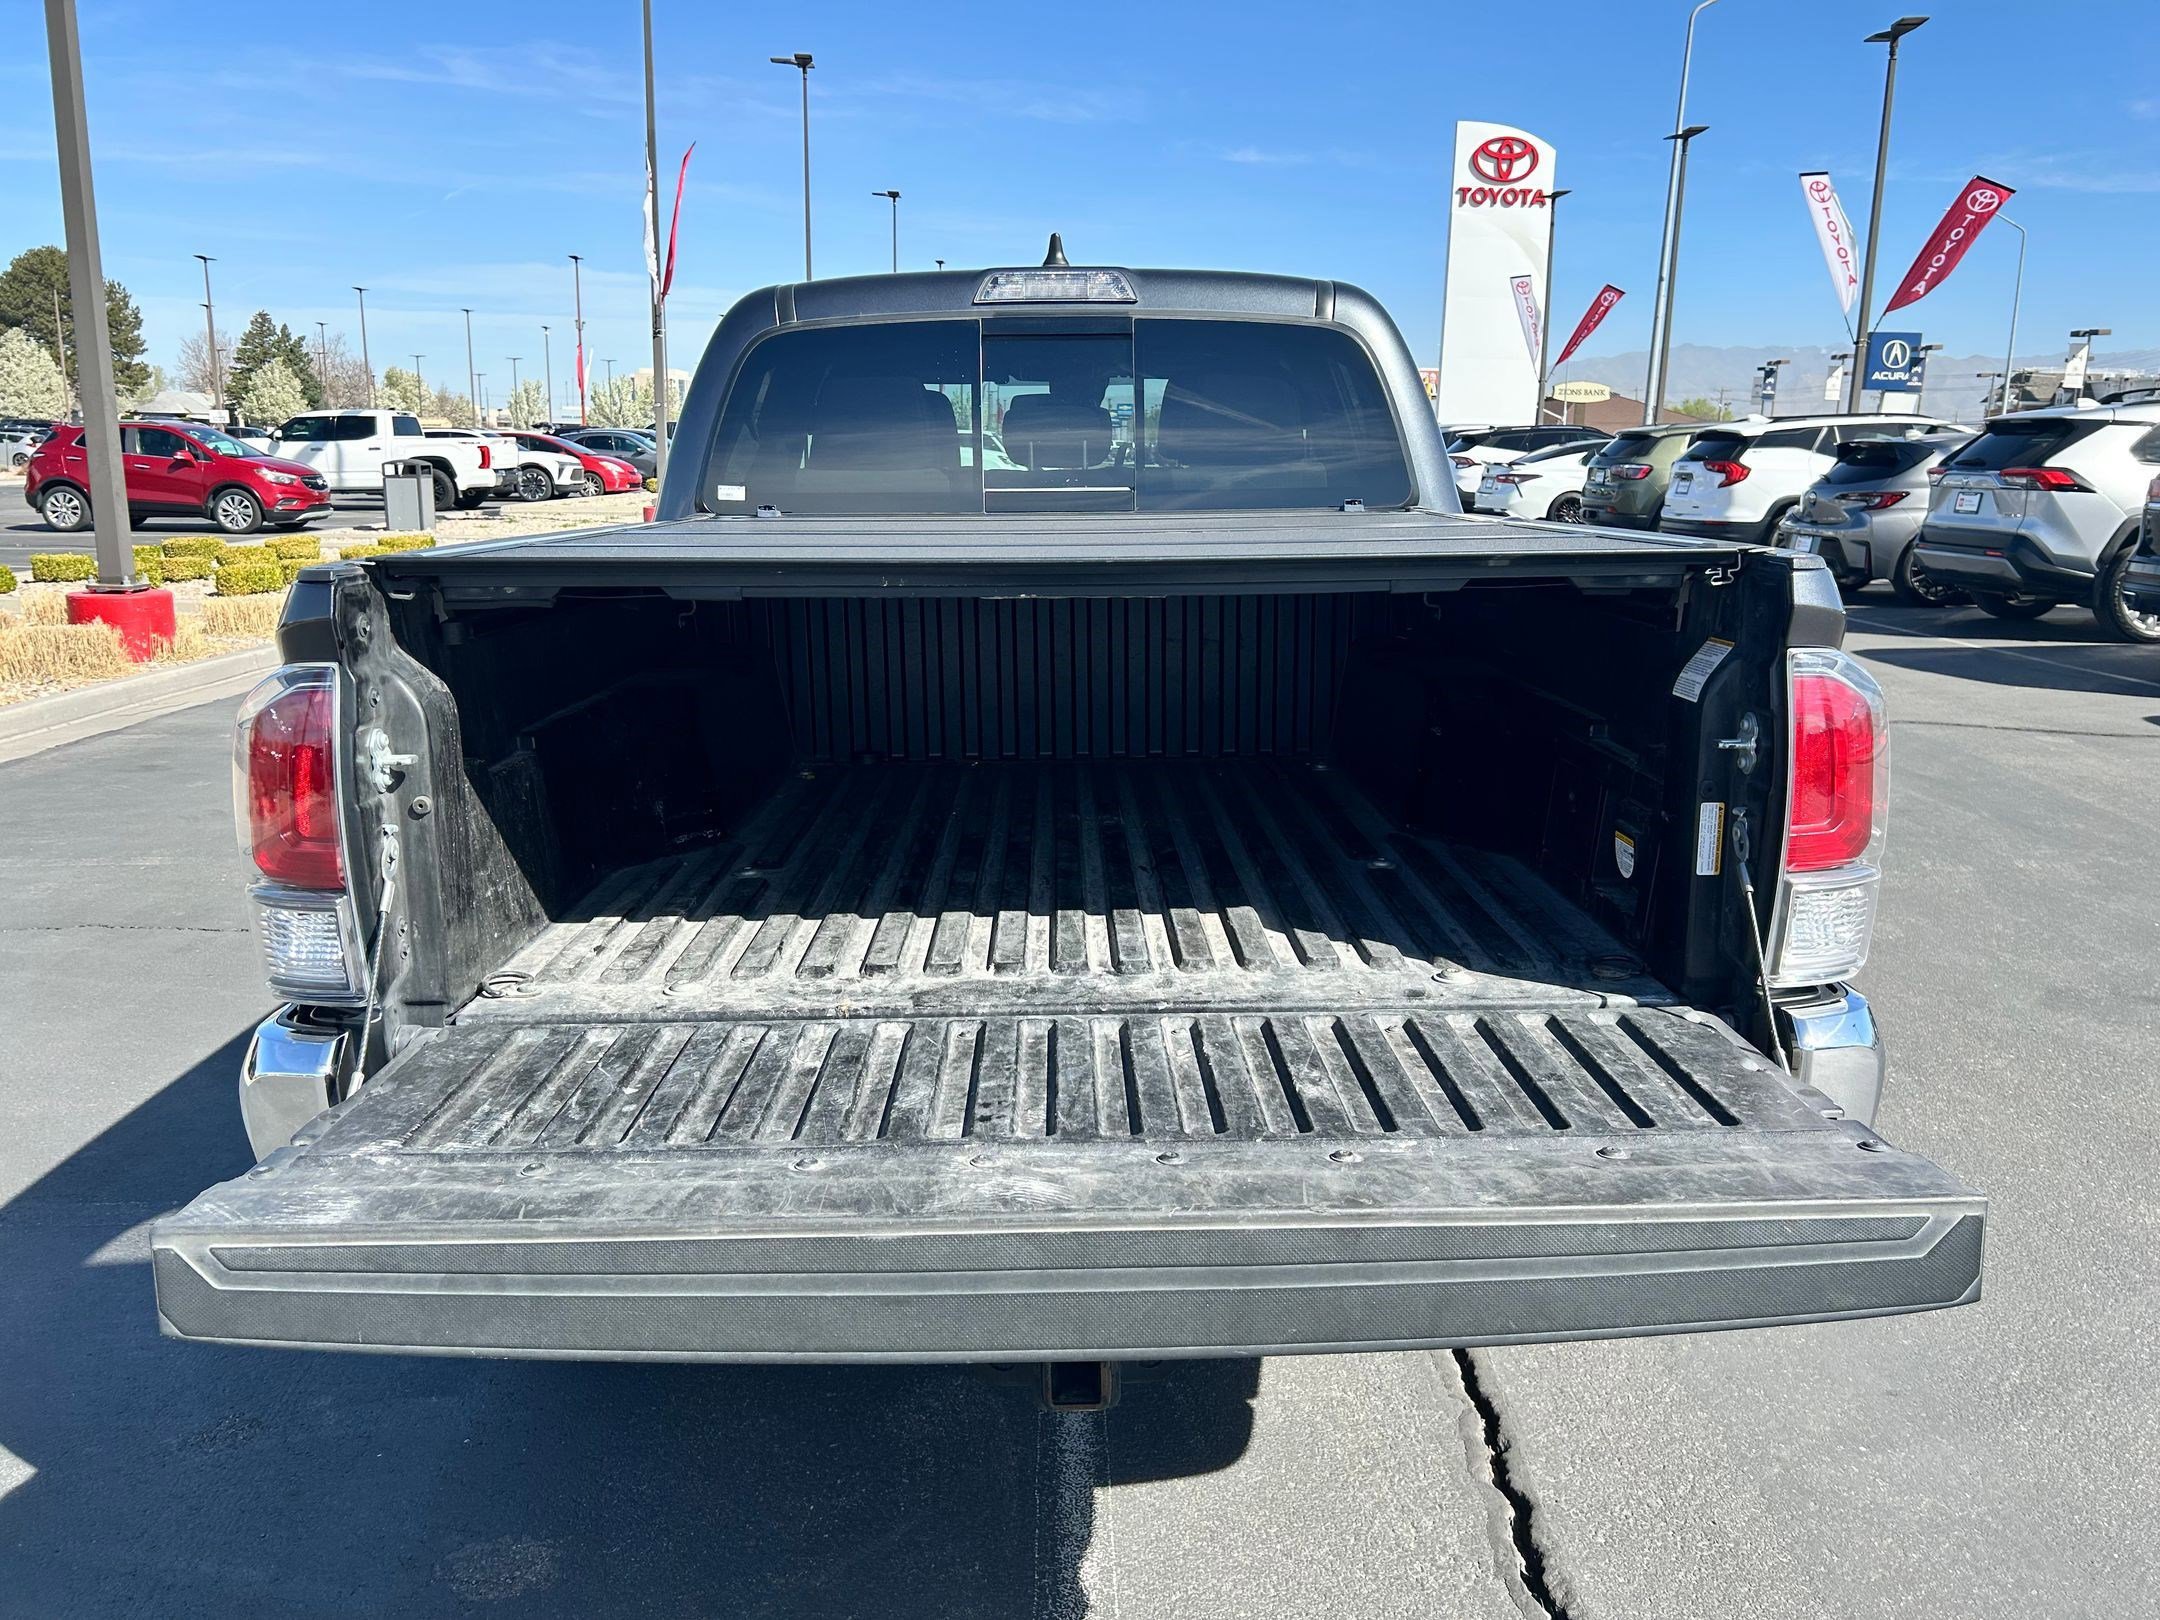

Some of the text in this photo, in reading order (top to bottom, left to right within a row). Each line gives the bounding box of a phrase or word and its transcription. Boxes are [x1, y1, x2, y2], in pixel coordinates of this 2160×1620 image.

[1457, 187, 1546, 207] TOYOTA
[1822, 207, 1857, 286] TOYOTA
[1911, 213, 1976, 295] TOYOTA
[1871, 371, 1910, 380] ACURA
[1583, 388, 1606, 396] BANK
